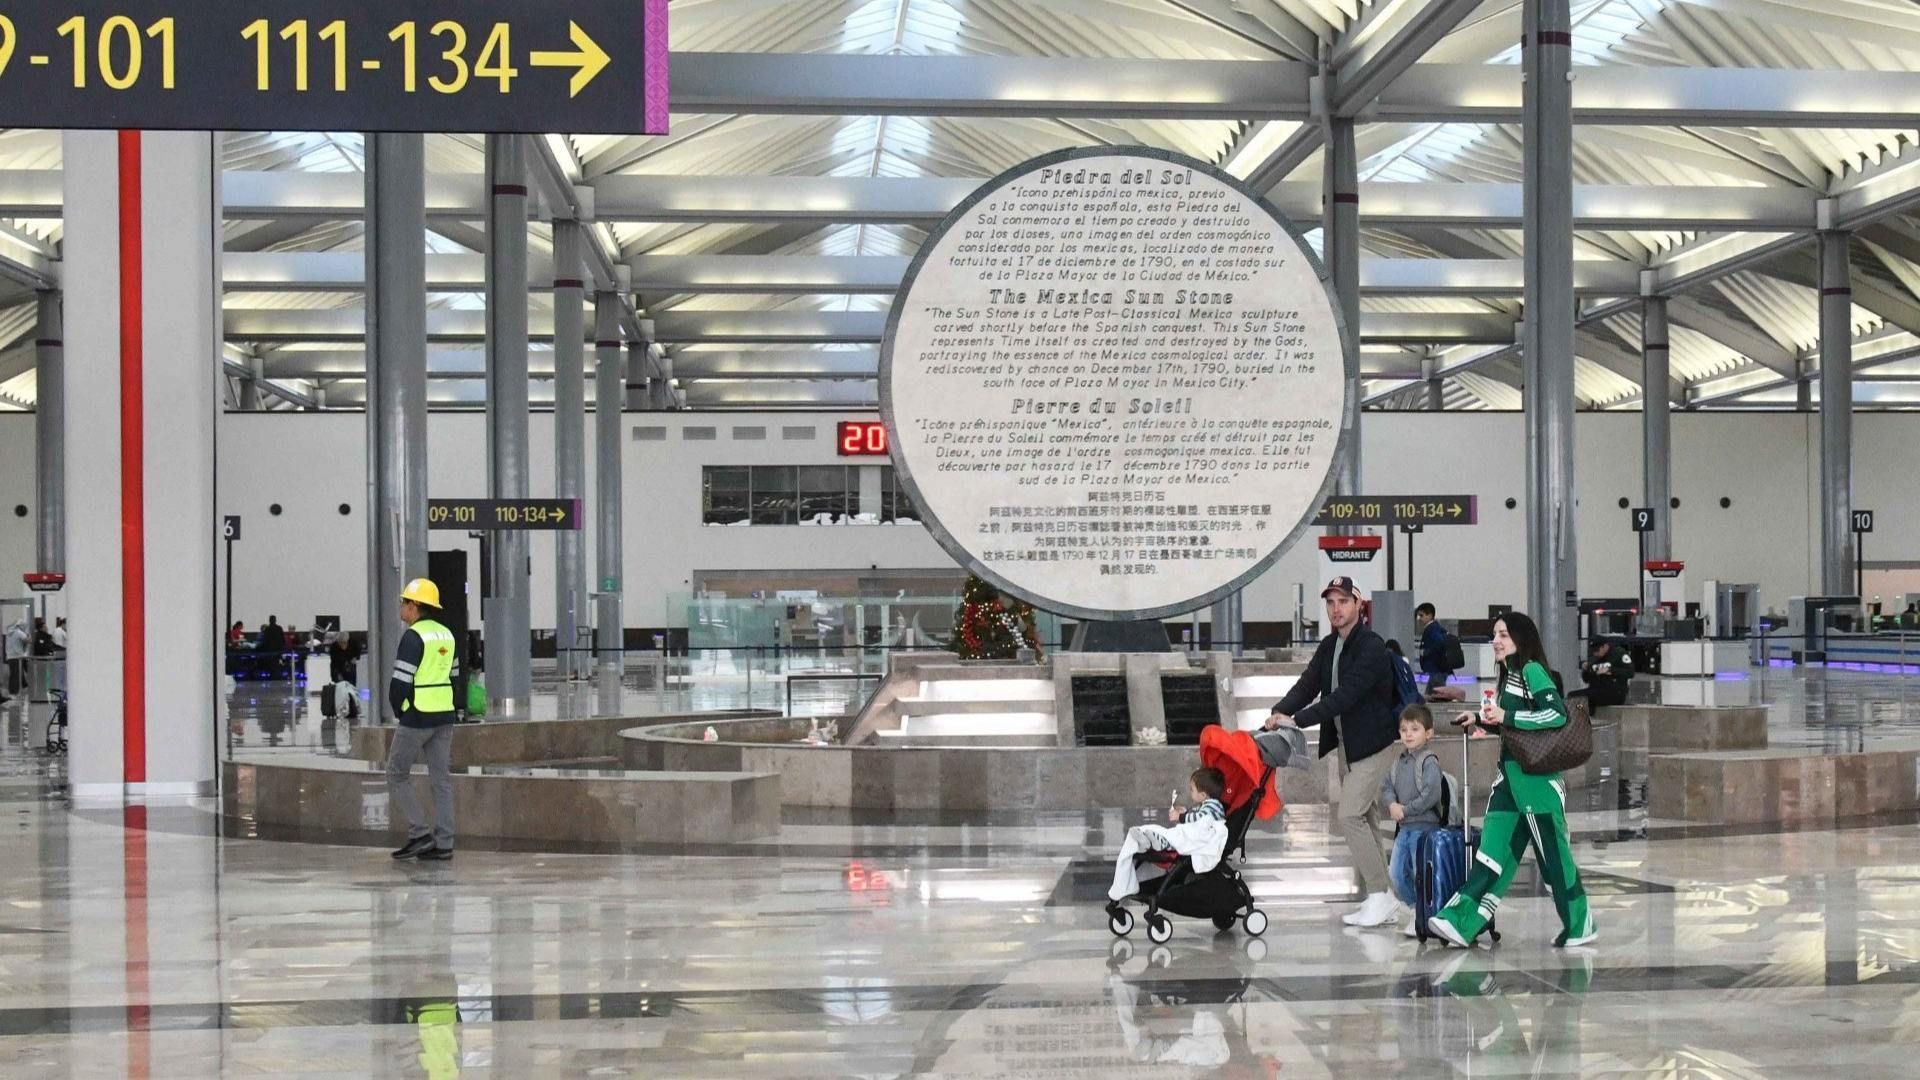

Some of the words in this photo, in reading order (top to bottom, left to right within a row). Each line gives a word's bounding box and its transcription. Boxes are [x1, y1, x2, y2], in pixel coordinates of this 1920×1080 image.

[240, 18, 518, 95] 111-134
[1040, 169, 1111, 184] Piedra
[1121, 169, 1151, 184] del
[1161, 169, 1192, 184] Sol
[1053, 187, 1131, 200] prehispánico
[1137, 188, 1183, 200] mexica,
[1189, 188, 1225, 201] previo
[1020, 201, 1078, 214] conquista
[1083, 201, 1141, 214] española,
[1147, 202, 1171, 212] esta
[1177, 202, 1218, 212] Piedra
[1224, 202, 1240, 213] del
[978, 214, 997, 224] Sol
[1003, 217, 1069, 225] conmemora
[1092, 215, 1133, 228] tiempo
[1137, 215, 1176, 225] creado
[1193, 215, 1250, 226] destruido
[966, 231, 984, 241] por
[991, 228, 1007, 238] los
[1013, 228, 1054, 240] dioses,
[1088, 228, 1132, 241] imagen
[1137, 229, 1154, 239] del
[1160, 229, 1191, 239] orden
[1198, 228, 1270, 242] cosmogónico
[959, 242, 1030, 252] considerado
[1035, 245, 1055, 255] por
[1060, 242, 1077, 253] los
[1083, 242, 1137, 255] mexicas,
[1144, 243, 1207, 253] localizado
[1211, 243, 1224, 253] de
[1229, 246, 1273, 254] manera
[950, 256, 997, 266] fortuita
[1019, 256, 1033, 266] 17
[1038, 256, 1051, 266] de
[1055, 256, 1116, 267] diciembre
[1123, 256, 1135, 267] de
[1140, 257, 1176, 269] 1790,
[1216, 257, 1260, 268] costado
[1265, 260, 1285, 268] sur
[979, 270, 992, 280] de
[1016, 270, 1053, 280] Plaza
[1059, 270, 1098, 283] Mayor
[1103, 270, 1116, 280] de
[1140, 270, 1182, 280] Ciudad
[1187, 270, 1200, 280] de
[990, 289, 1026, 304] The
[1038, 289, 1112, 304] Mexica
[1124, 289, 1164, 304] Sun
[1175, 289, 1233, 304] Stone
[956, 308, 980, 318] Sun
[987, 308, 1019, 318] Stone
[1054, 308, 1079, 318] Late
[1084, 308, 1180, 318] Post-Classical
[1190, 308, 1233, 319] Mexica
[1242, 308, 1298, 321] sculpture
[934, 322, 974, 332] carved
[980, 322, 1024, 335] shortly
[1030, 322, 1066, 332] before
[1072, 322, 1088, 332] the
[1096, 322, 1146, 335] Spanish
[1152, 322, 1205, 335] conquest.
[1214, 322, 1238, 332] This
[1244, 322, 1267, 332] Sun
[1274, 322, 1305, 332] Stone
[931, 336, 994, 349] represents
[1002, 336, 1030, 346] Time
[1035, 336, 1069, 346] itself
[1092, 336, 1138, 346] created
[1145, 336, 1165, 346] and
[1171, 336, 1227, 349] destroyed
[1234, 336, 1247, 349] by
[1254, 336, 1271, 346] the
[1275, 336, 1307, 348] Gods,
[920, 349, 986, 362] portraying
[993, 349, 1009, 360] the
[1014, 352, 1058, 360] essence
[1080, 349, 1096, 360] the
[1101, 349, 1146, 360] Mexica
[1151, 349, 1228, 362] cosmological
[1234, 349, 1267, 360] order.
[1275, 349, 1288, 360] It
[1294, 352, 1314, 360] was
[926, 363, 1002, 374] rediscovered
[1008, 363, 1023, 376] by
[1028, 363, 1069, 374] chance
[1091, 363, 1152, 373] December
[1157, 363, 1187, 375] 17th,
[1194, 363, 1229, 375] 1790,
[1235, 363, 1274, 373] buried
[1298, 363, 1315, 373] the
[984, 377, 1014, 387] south
[1021, 377, 1045, 387] face
[1065, 377, 1102, 387] Plaza
[1108, 377, 1149, 390] Mayor
[1173, 377, 1215, 388] Mexico
[1011, 398, 1080, 413] Pierre
[1089, 398, 1116, 413] du
[1129, 398, 1192, 413] Soleil
[1123, 418, 1186, 429] antérieure
[1219, 417, 1268, 431] conquête
[1272, 418, 1333, 431] espagnole,
[943, 433, 984, 444] Pierre
[988, 433, 1002, 443] du
[1008, 433, 1044, 443] Soleil
[1049, 432, 1119, 443] commémore
[1141, 432, 1175, 445] temps
[1181, 431, 1206, 443] créé
[1225, 431, 1267, 442] détruit
[1272, 435, 1292, 445] par
[1298, 432, 1315, 442] les
[936, 448, 975, 460] Dieux,
[1007, 447, 1043, 460] image
[1047, 447, 1060, 457] de
[1067, 446, 1111, 457] l'ordre
[1124, 446, 1205, 459] cosmogonique
[1209, 445, 1255, 455] mexica.
[1262, 444, 1289, 455] Elle
[1294, 444, 1310, 455] fut
[938, 460, 1000, 472] découverte
[1006, 464, 1025, 474] par
[1032, 461, 1075, 471] hasard
[1096, 460, 1111, 471] 17
[1124, 459, 1180, 471] décembre
[1185, 460, 1217, 470] 1790
[1222, 460, 1250, 470] dans
[1273, 459, 1310, 472] partie
[1019, 474, 1039, 485] sud
[1045, 474, 1058, 485] de
[1081, 474, 1118, 484] Plaza
[1124, 473, 1163, 486] Mayor
[1168, 473, 1181, 484] de
[496, 506, 547, 522] 110-134
[1330, 503, 1381, 518] 109-101
[1394, 503, 1444, 518] 110-134
[1638, 511, 1648, 528] 9
[1854, 512, 1871, 529] 10
[223, 519, 234, 537] 6
[1332, 550, 1371, 560] HIDRANTE
